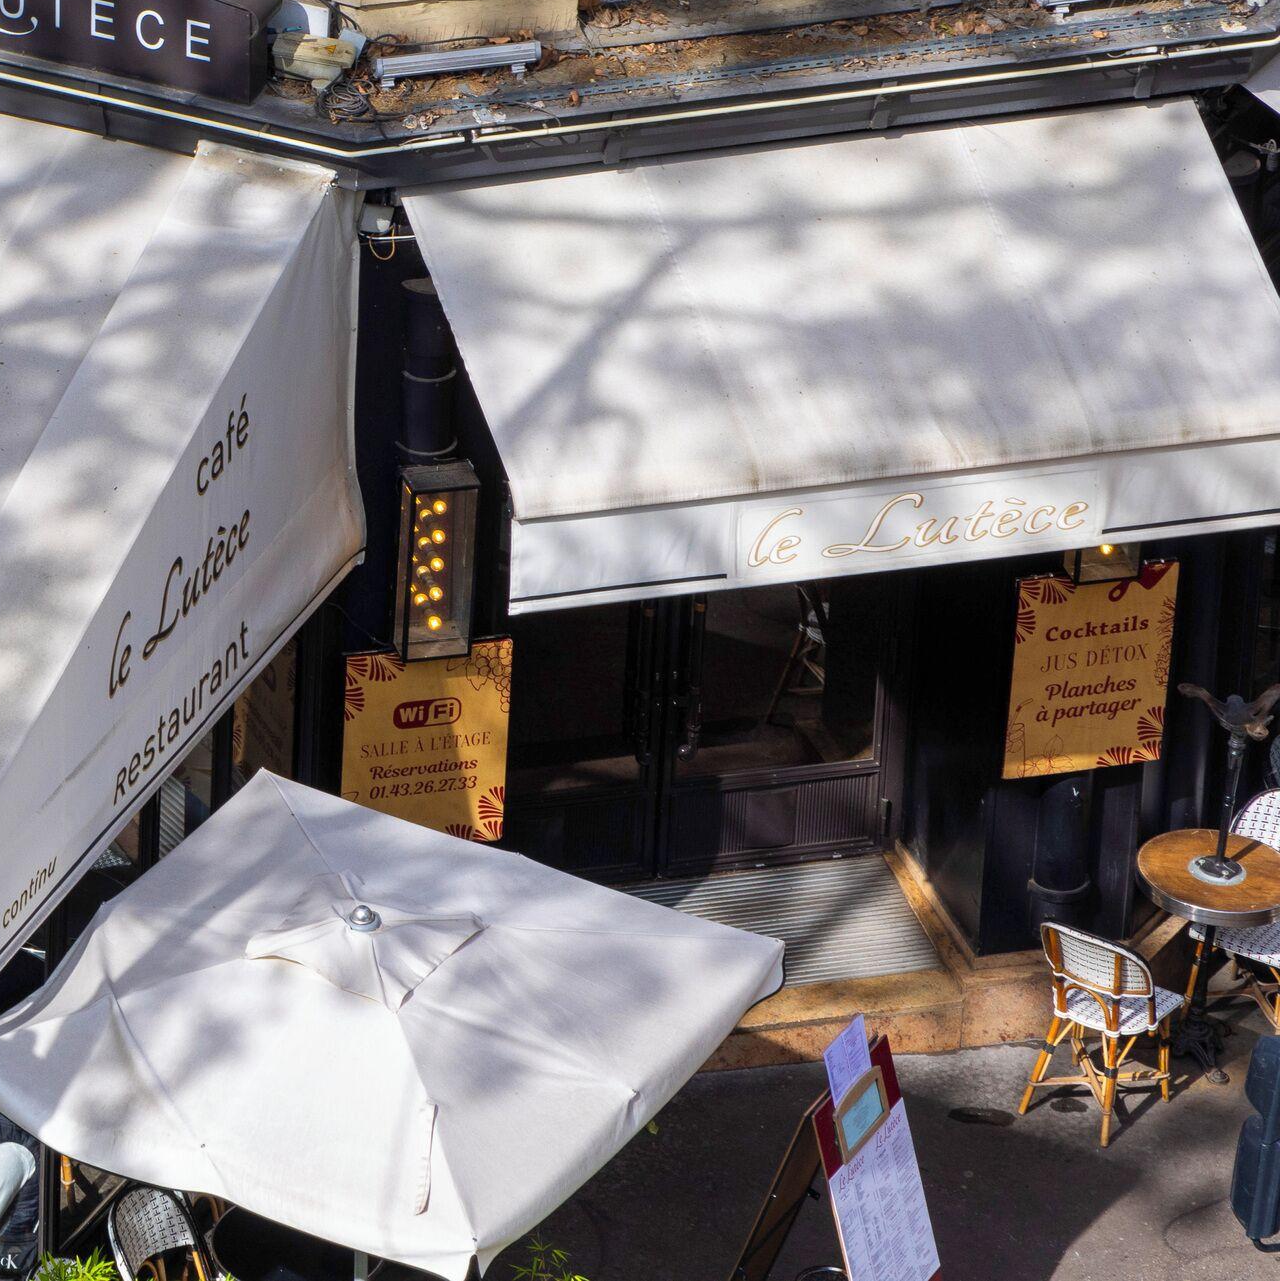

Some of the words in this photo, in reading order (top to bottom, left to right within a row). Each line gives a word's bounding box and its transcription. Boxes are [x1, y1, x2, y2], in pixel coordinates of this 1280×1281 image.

[197, 393, 250, 497] café
[747, 507, 803, 568] le
[821, 492, 1090, 558] Lutèce
[108, 610, 131, 700] le
[143, 509, 251, 662] Lutèce
[1045, 615, 1149, 642] Cocktails
[1040, 652, 1078, 673] JUS
[1085, 643, 1148, 668] DÉTOX
[1044, 675, 1138, 701] Planches
[1036, 705, 1049, 723] à
[1051, 698, 1142, 728] partager
[360, 739, 409, 759] SALLE
[414, 736, 425, 754] À
[431, 730, 491, 751] L'ÉTAGE
[369, 758, 478, 780] Réservations
[369, 775, 478, 799] 01.43.26.27.33
[2, 856, 58, 928] continu
